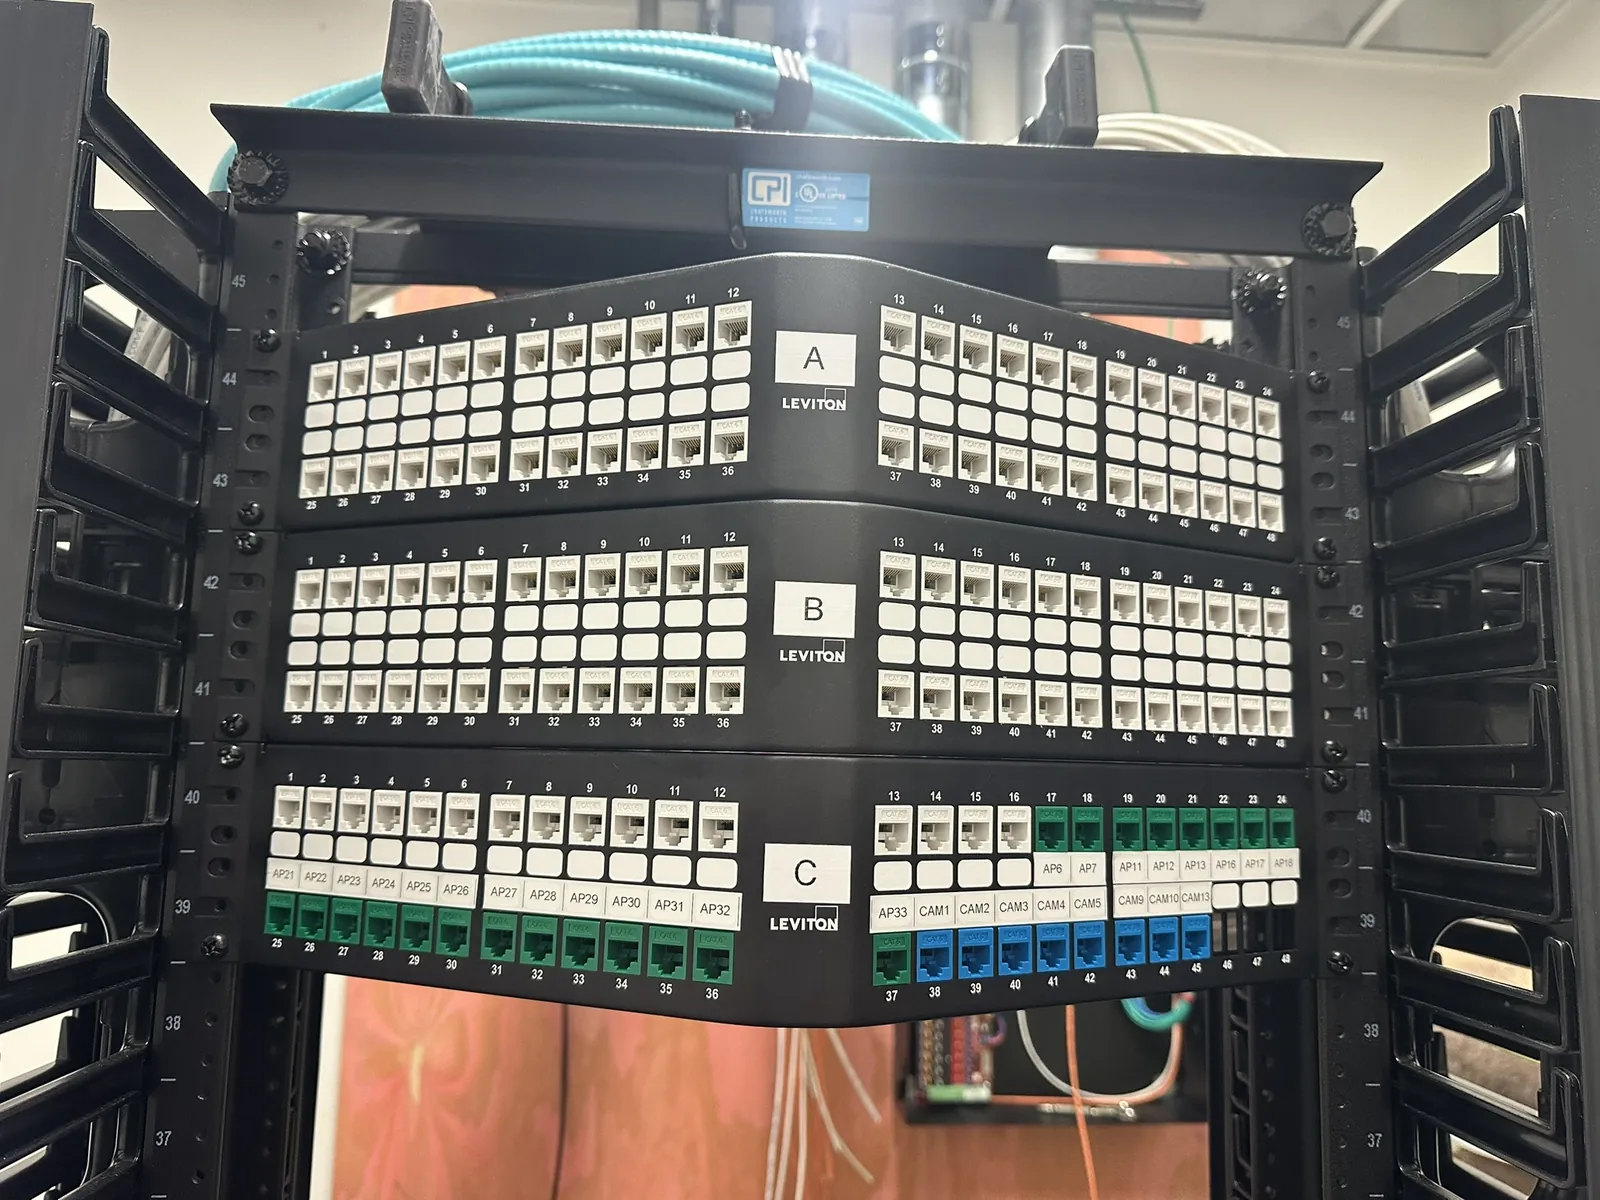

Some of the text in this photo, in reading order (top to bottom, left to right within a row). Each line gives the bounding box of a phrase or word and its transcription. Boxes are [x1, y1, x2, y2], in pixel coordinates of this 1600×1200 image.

[231, 274, 246, 288] 45
[530, 287, 740, 327] 7 8 9 10 11 12
[894, 294, 1087, 350] 13 14 15 16 17 18
[803, 346, 825, 370] A
[222, 372, 237, 385] 44
[782, 397, 846, 411] LEVITON
[1341, 410, 1355, 423] 44
[213, 473, 228, 487] 43
[519, 465, 734, 492] 31 32 33 34 35 36
[890, 471, 1087, 512] 37 38 39 40 41 42
[1344, 507, 1360, 520] 43
[522, 531, 736, 553] 7 8 9 10 11 12
[893, 537, 1091, 571] 13 14 15 16 17 18
[203, 575, 219, 589] 42
[804, 597, 823, 621] B
[1349, 604, 1363, 618] 42
[779, 649, 845, 663] LEVITON
[195, 682, 210, 696] 41
[1354, 707, 1368, 720] 41
[509, 716, 730, 728] 31 32 33 34 35 36
[890, 721, 1092, 740] 37 38 39 40 41 42
[288, 772, 467, 789] 1 2 3 4 5 6
[506, 780, 726, 798] 7 8 9 10 11 12
[888, 790, 1093, 803] 13 14 15 16 17 18
[184, 790, 200, 804] 40
[1123, 793, 1287, 804] 19 20 21 22 23 24
[1357, 809, 1371, 823] 40
[794, 859, 817, 886] C
[1043, 863, 1097, 874] AP6 AP7
[1119, 858, 1293, 872] AP11 AP12 AP13 AP16 AP17 AP18
[272, 868, 469, 896] AP21 AP22 AP23 AP24 AP25 AP26
[490, 886, 731, 916] AP27 AP28 AP29 AP30 AP31 AP32
[1118, 891, 1210, 906] CAM9 CAM10 CAM13
[175, 899, 191, 914] 39
[878, 898, 1102, 919] AP33 CAM1 CAM2 CAM3 CAM4 CAM5
[770, 917, 838, 931] LEVITON
[1360, 913, 1375, 928] 39
[272, 938, 457, 970] 25 26 27 28 29 30
[1126, 956, 1262, 979] 43 44 45 46 47
[491, 964, 719, 1000] 31 32 33 34 35 36
[886, 972, 1095, 1002] 37 38 39 40 41 42
[165, 1015, 181, 1031] 38
[1364, 1023, 1379, 1038] 38
[156, 1130, 172, 1146] 37
[1367, 1133, 1382, 1148] 37
